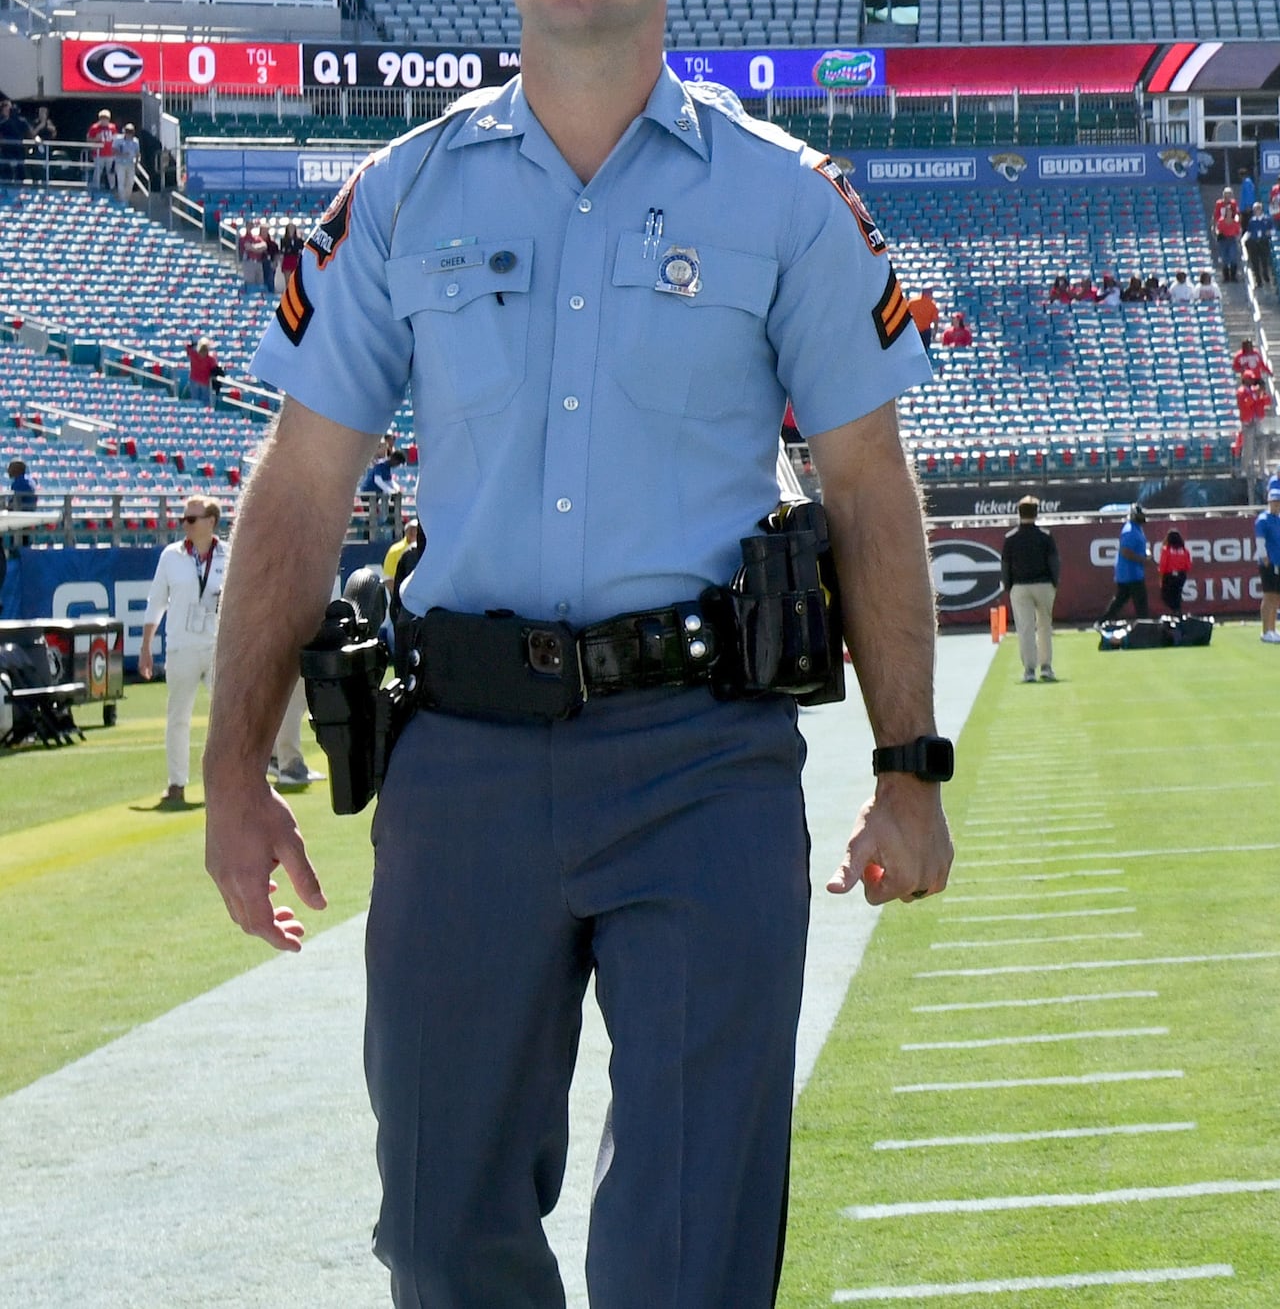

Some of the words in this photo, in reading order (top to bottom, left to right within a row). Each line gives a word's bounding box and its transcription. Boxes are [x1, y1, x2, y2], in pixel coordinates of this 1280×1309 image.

[188, 45, 216, 85] 0
[246, 48, 278, 67] TOL
[684, 56, 714, 74] TOL
[256, 66, 268, 84] 3
[313, 50, 358, 85] Q1
[377, 51, 482, 88] 90:00
[498, 51, 521, 68] BA
[749, 55, 775, 90] 0
[871, 163, 913, 178] BUD
[914, 161, 973, 177] LIGHT
[1042, 159, 1084, 175] BUD
[1085, 157, 1142, 173] LIGHT
[440, 256, 466, 268] CHEEK
[975, 498, 1061, 515] ticketter
[1090, 537, 1268, 568] GRGI
